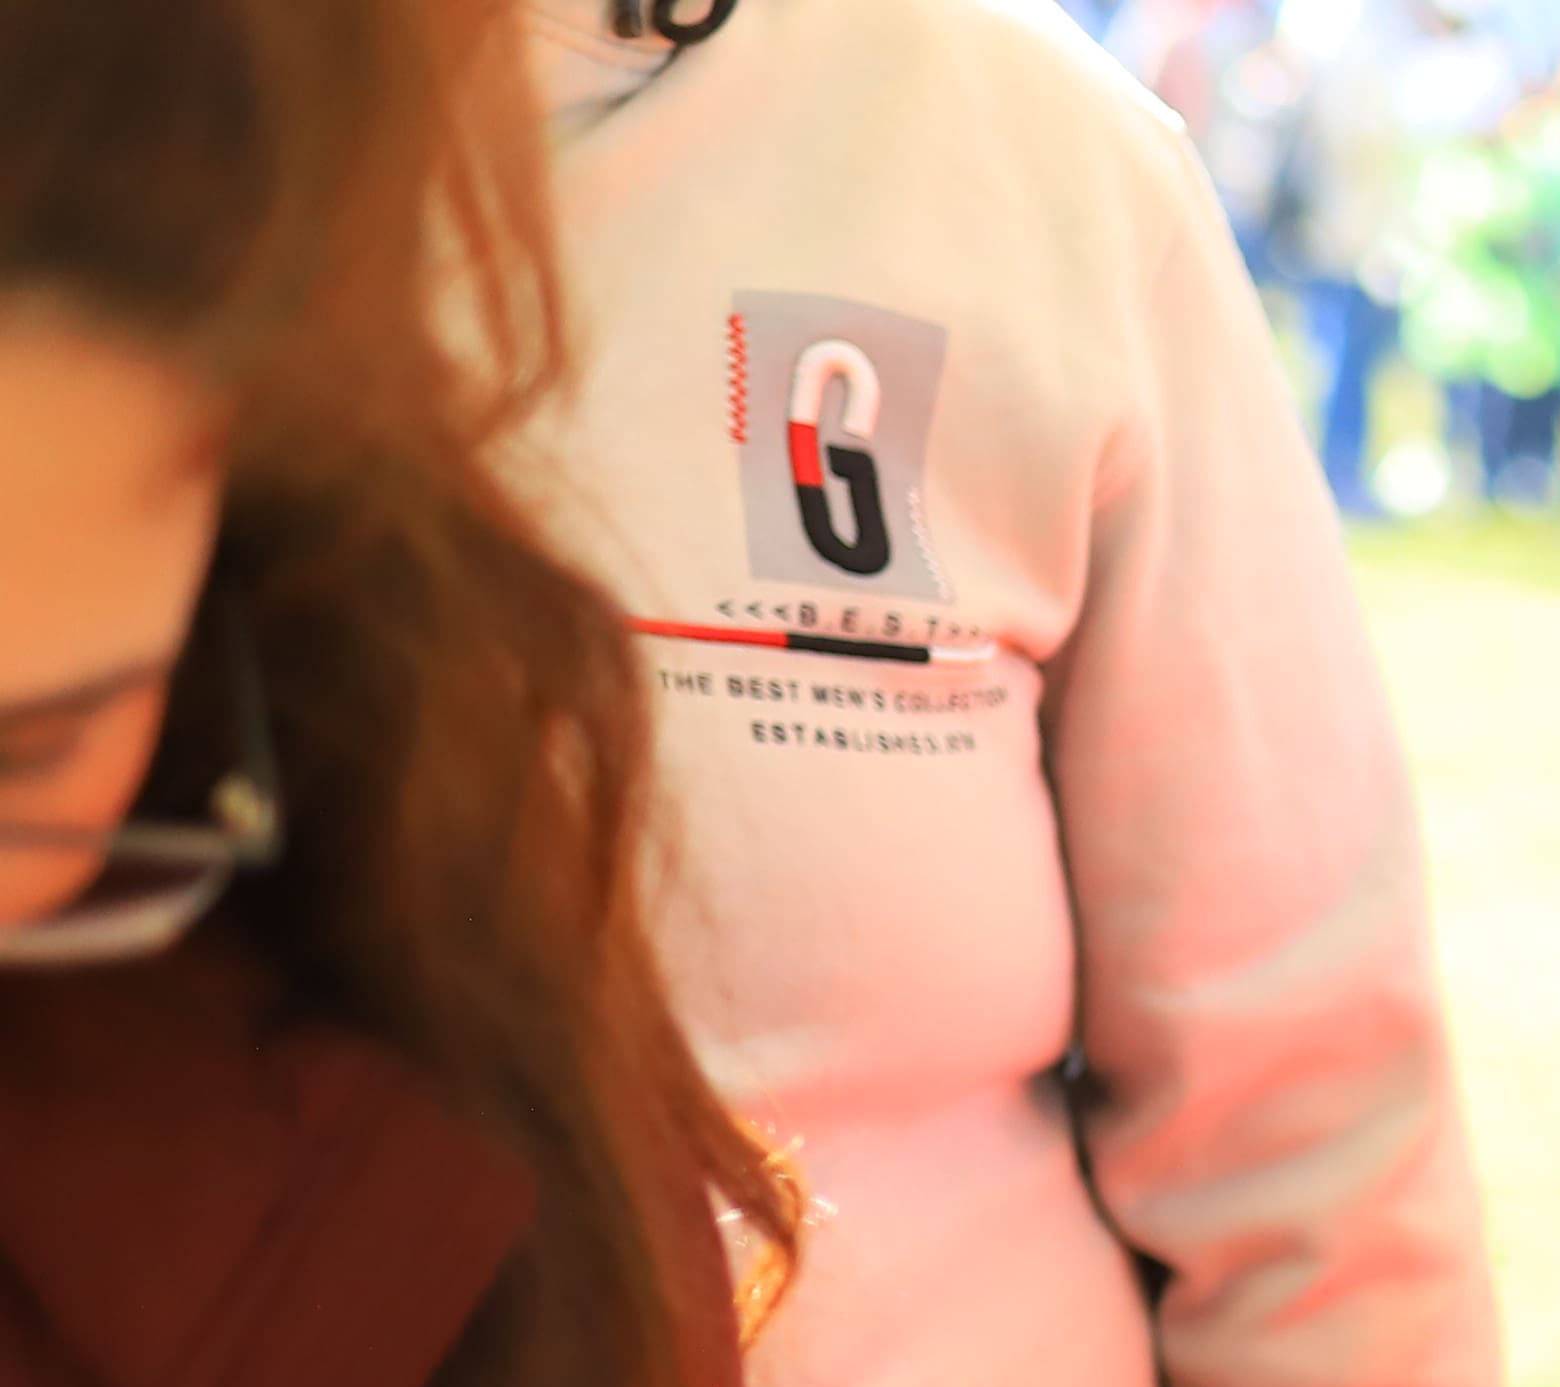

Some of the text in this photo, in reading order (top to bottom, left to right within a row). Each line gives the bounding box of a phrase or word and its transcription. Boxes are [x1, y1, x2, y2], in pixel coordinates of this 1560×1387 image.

[788, 338, 890, 577] G
[657, 669, 713, 696] THE
[727, 673, 800, 700] BEST
